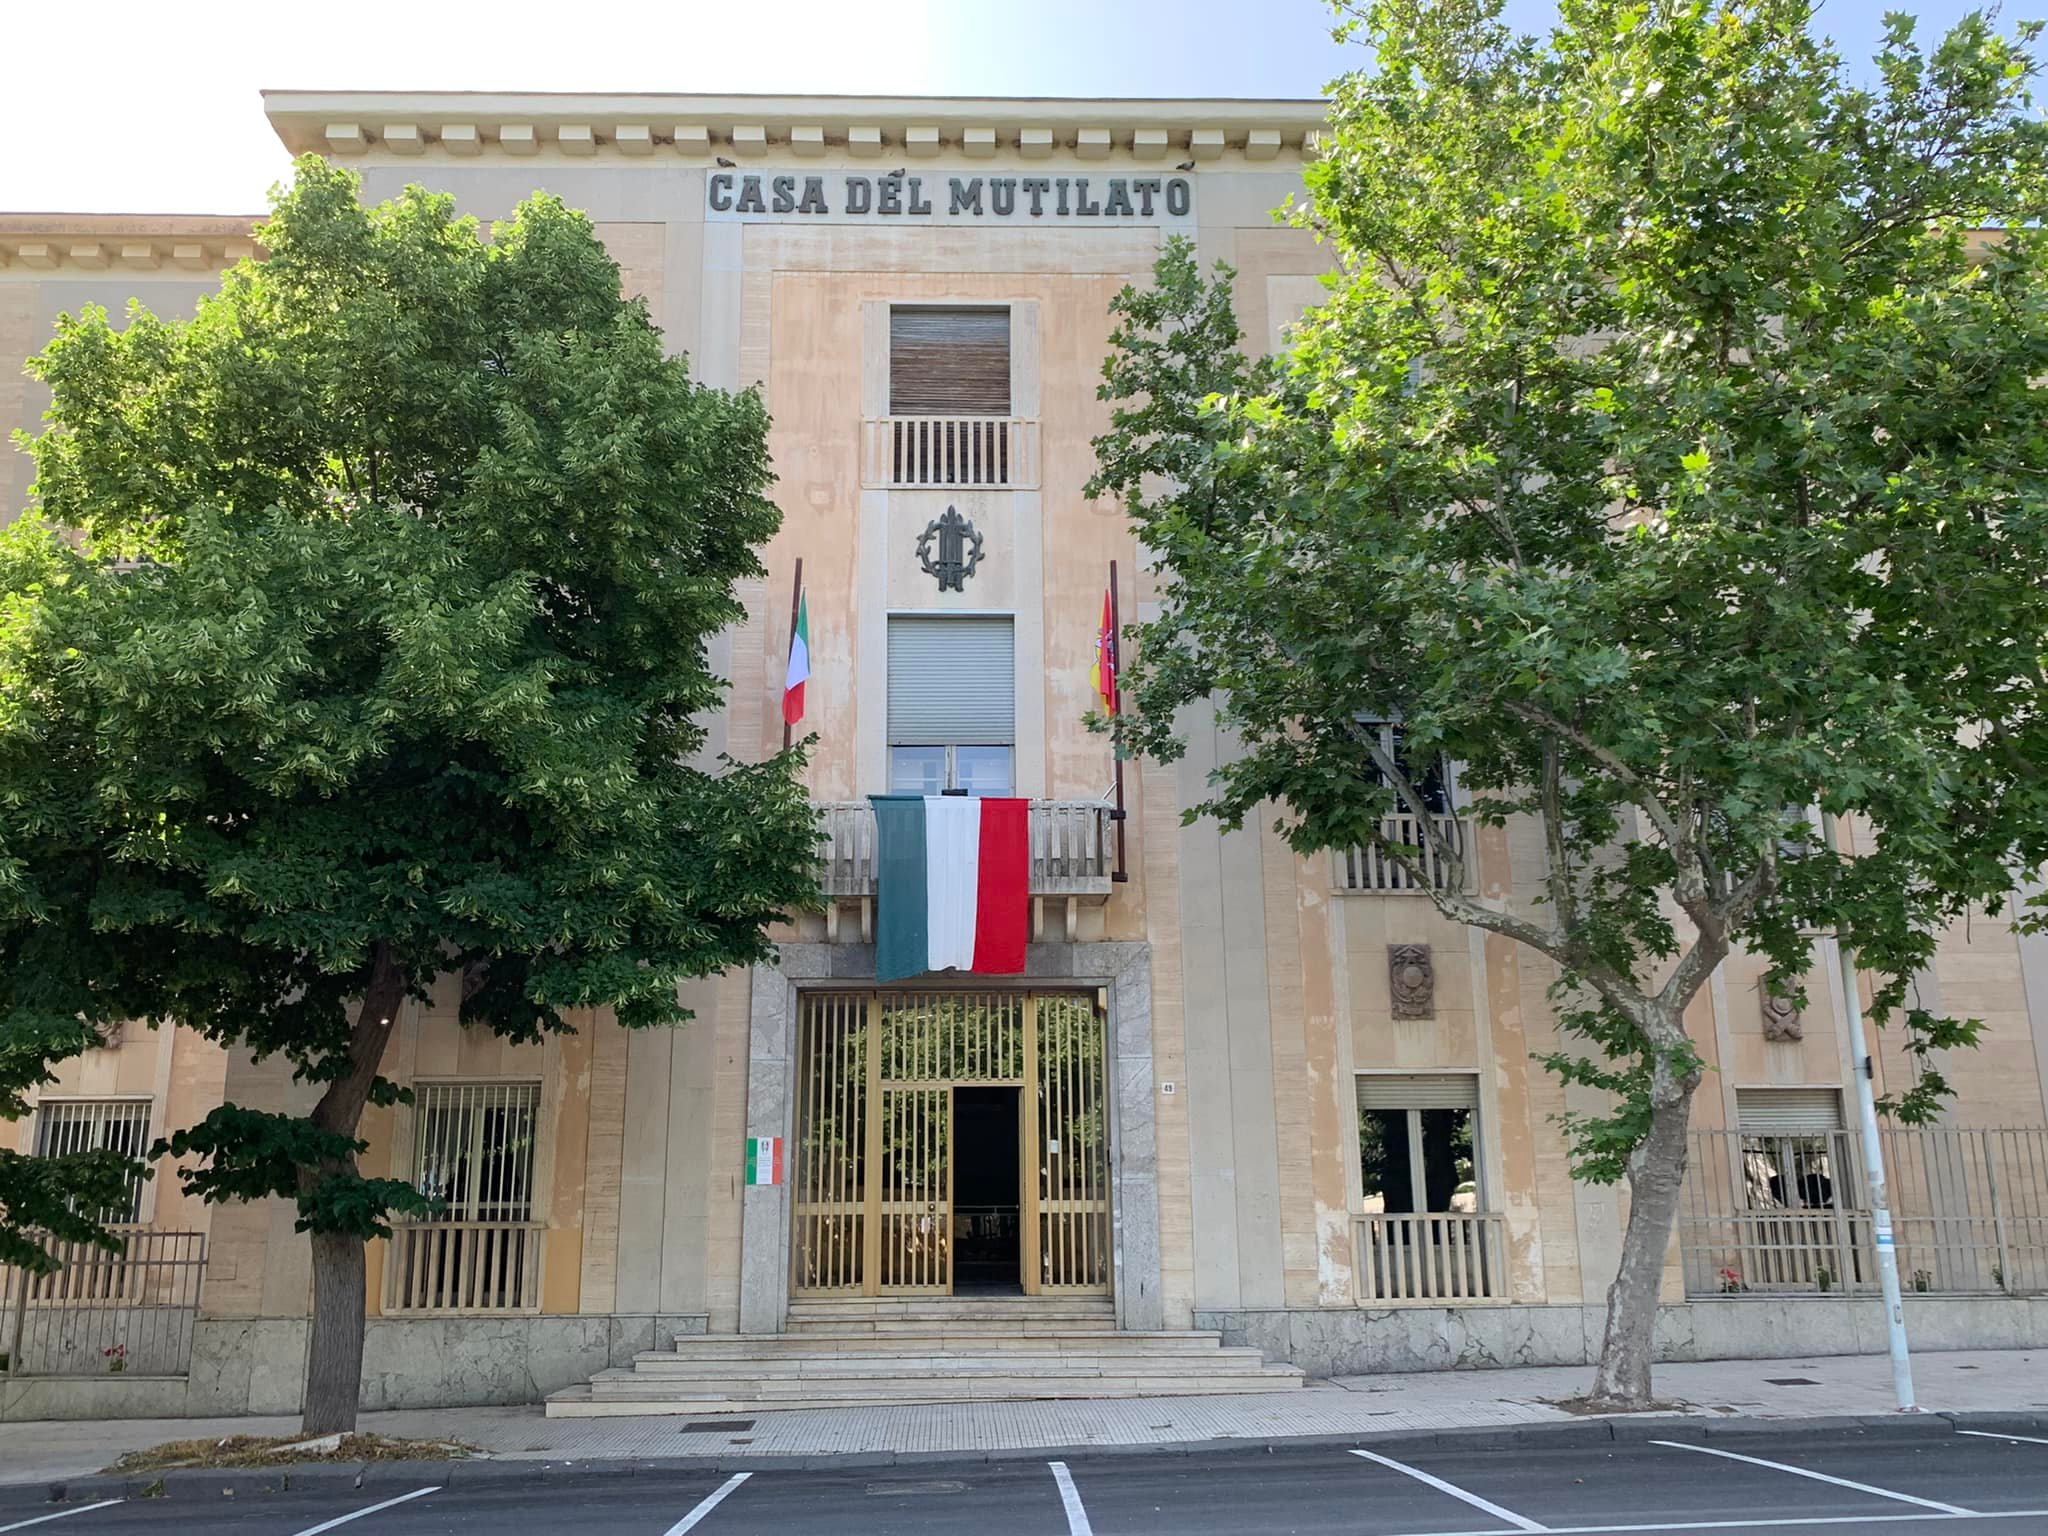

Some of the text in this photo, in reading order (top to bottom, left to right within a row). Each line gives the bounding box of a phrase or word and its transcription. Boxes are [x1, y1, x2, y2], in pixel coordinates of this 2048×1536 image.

[709, 174, 1190, 216] CASA DEL MUTILATO
